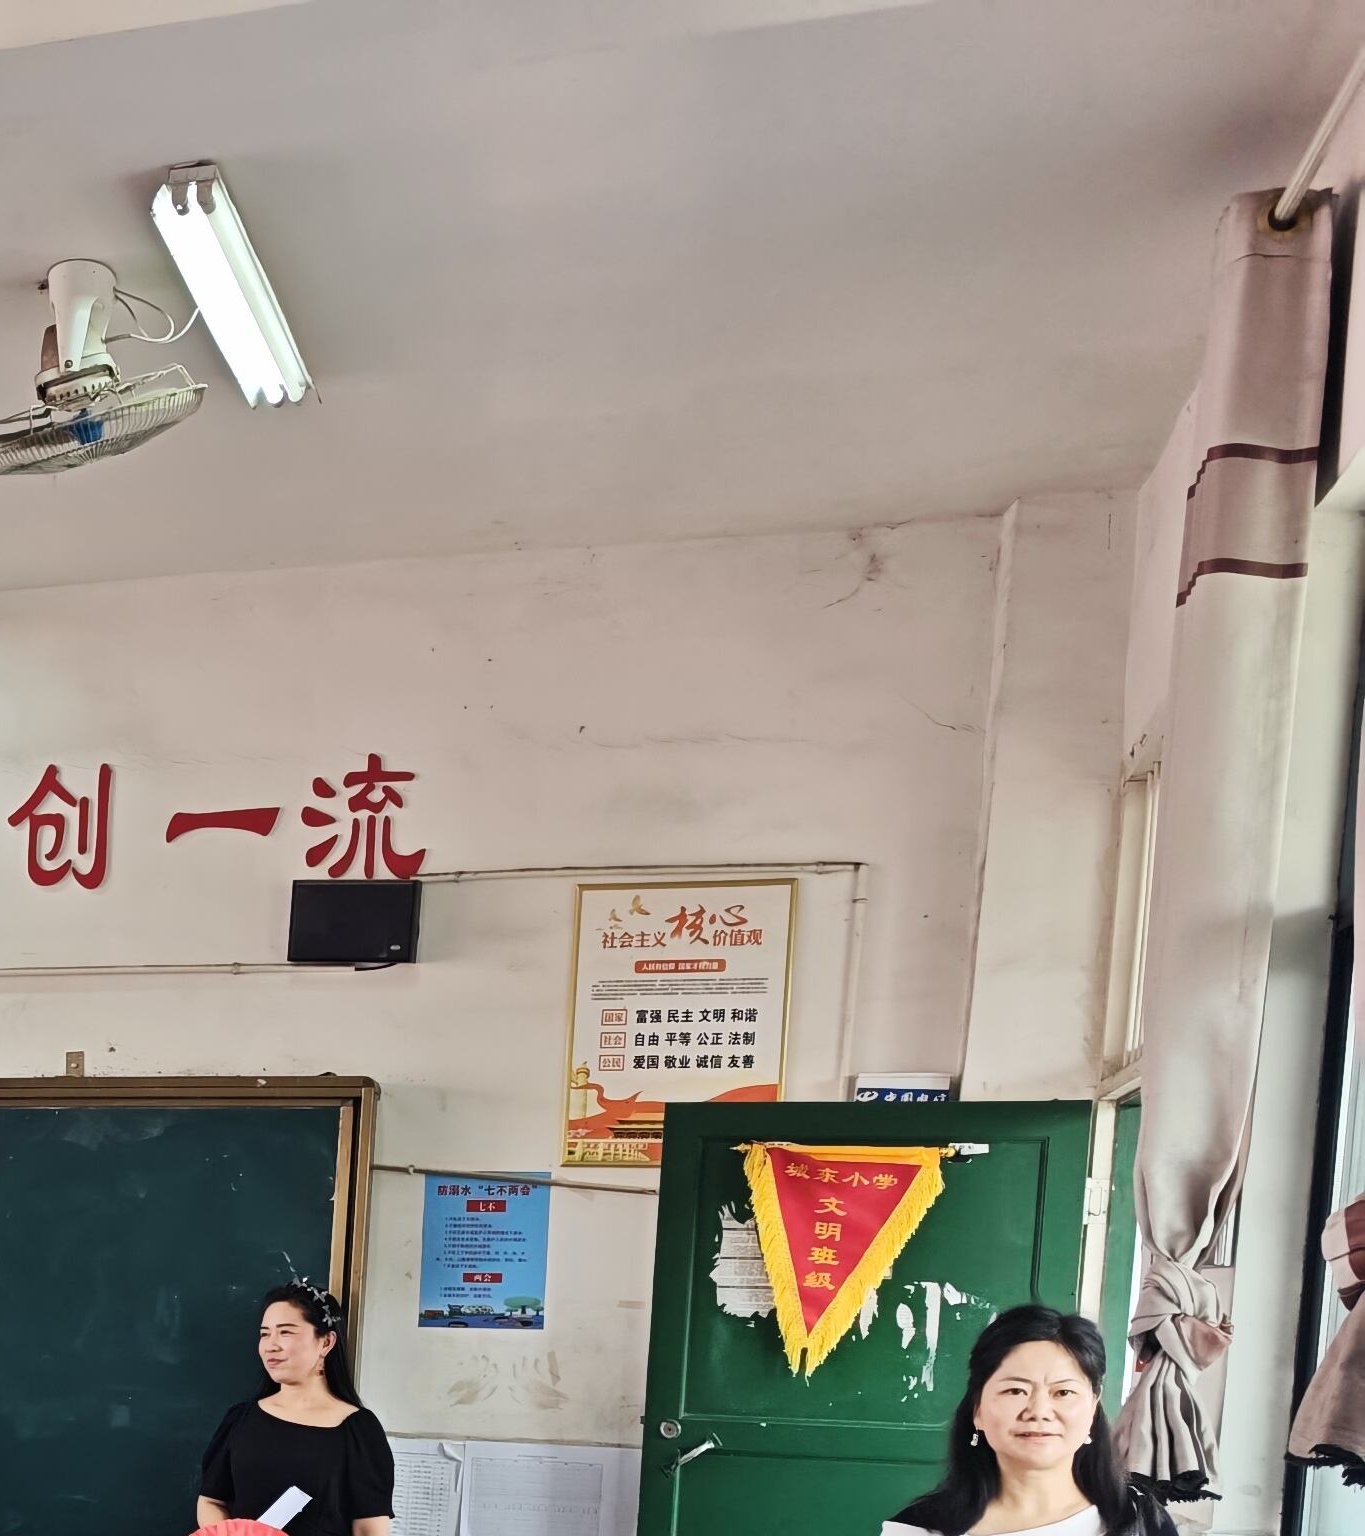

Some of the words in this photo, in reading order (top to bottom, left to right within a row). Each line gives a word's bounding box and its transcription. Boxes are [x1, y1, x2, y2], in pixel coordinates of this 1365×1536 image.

[601, 931, 668, 950] 社会主义
[665, 904, 749, 945] 核心
[712, 928, 764, 947] 价值观
[635, 1009, 662, 1024] 富强
[666, 1009, 694, 1023] 民主
[698, 1008, 726, 1023] 文明
[730, 1008, 758, 1023] 和谐
[634, 1032, 660, 1047] 自由
[664, 1031, 692, 1047] 平等
[696, 1032, 723, 1046] 公正
[602, 1057, 621, 1068] 公民
[633, 1055, 660, 1070] 爱国
[664, 1055, 691, 1069] 敬业
[696, 1054, 722, 1069] 诚信
[727, 1054, 755, 1069] 友善
[784, 1162, 899, 1190] 城东小学
[802, 1196, 848, 1291] 文明班级
